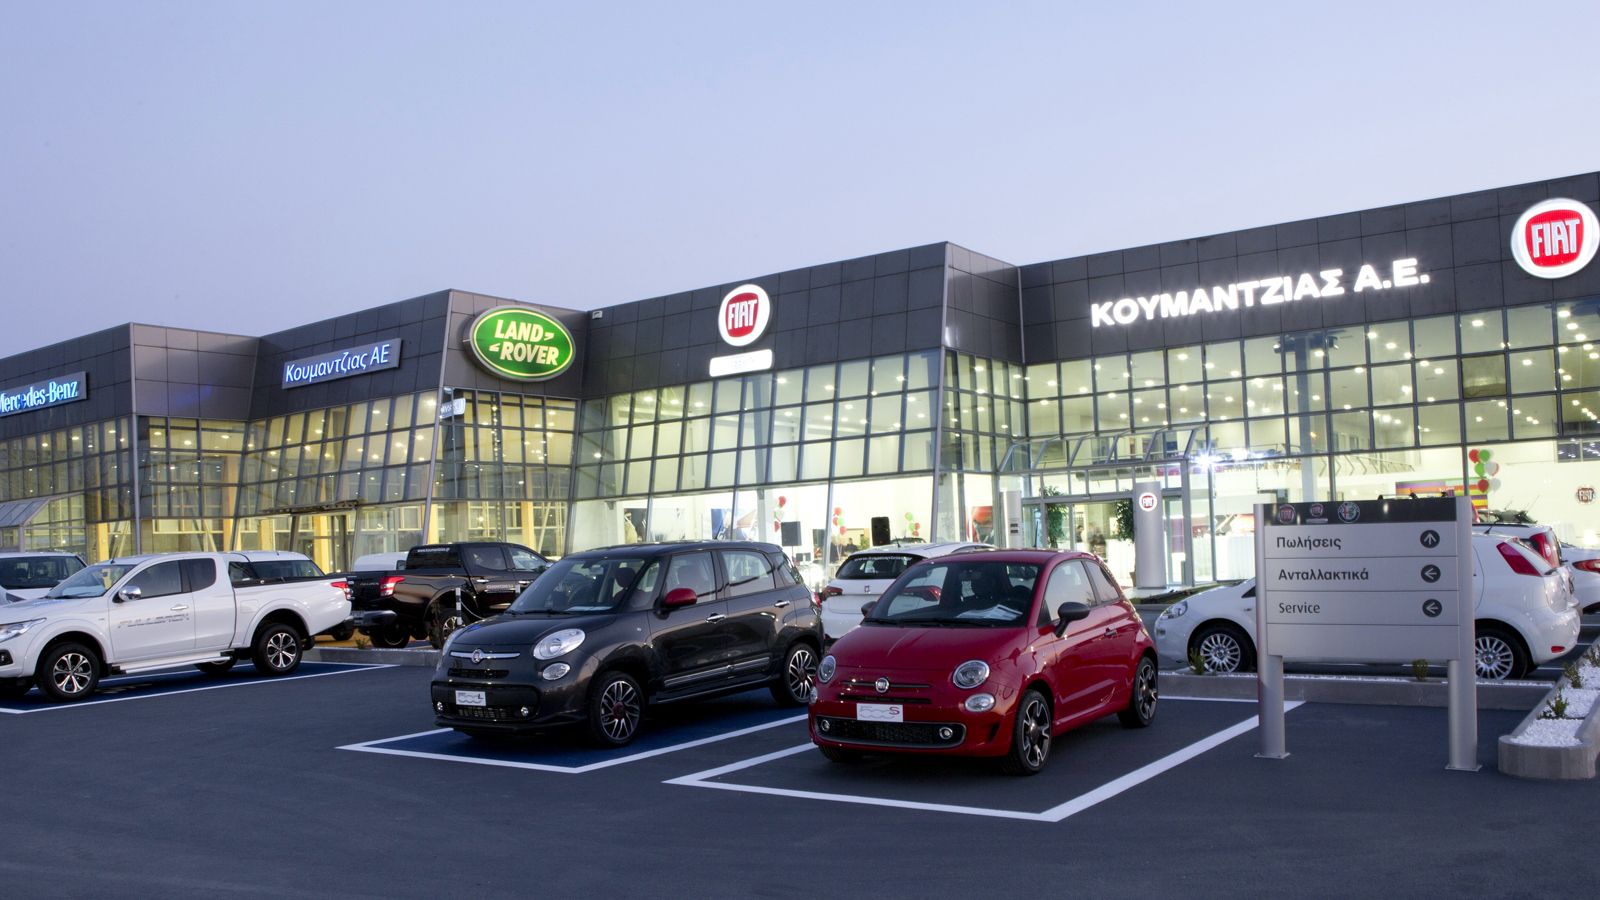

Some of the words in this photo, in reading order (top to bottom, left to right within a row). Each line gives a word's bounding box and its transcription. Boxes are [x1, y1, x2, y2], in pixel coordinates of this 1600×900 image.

[1531, 218, 1580, 258] FIAT
[1090, 268, 1345, 328] ΚΟΥΜΑΝΤΖΙΑΣ
[1354, 257, 1431, 293] Α.Ε.
[728, 299, 758, 331] FIAT
[494, 319, 544, 343] LAND
[285, 352, 368, 382] Κουμαντζιας
[370, 343, 390, 365] ΑΕ
[499, 341, 560, 366] ROVER
[1276, 536, 1342, 550] Πωλήσεις
[1278, 567, 1369, 581] Ανταλλακτικά
[1278, 601, 1320, 614] Service
